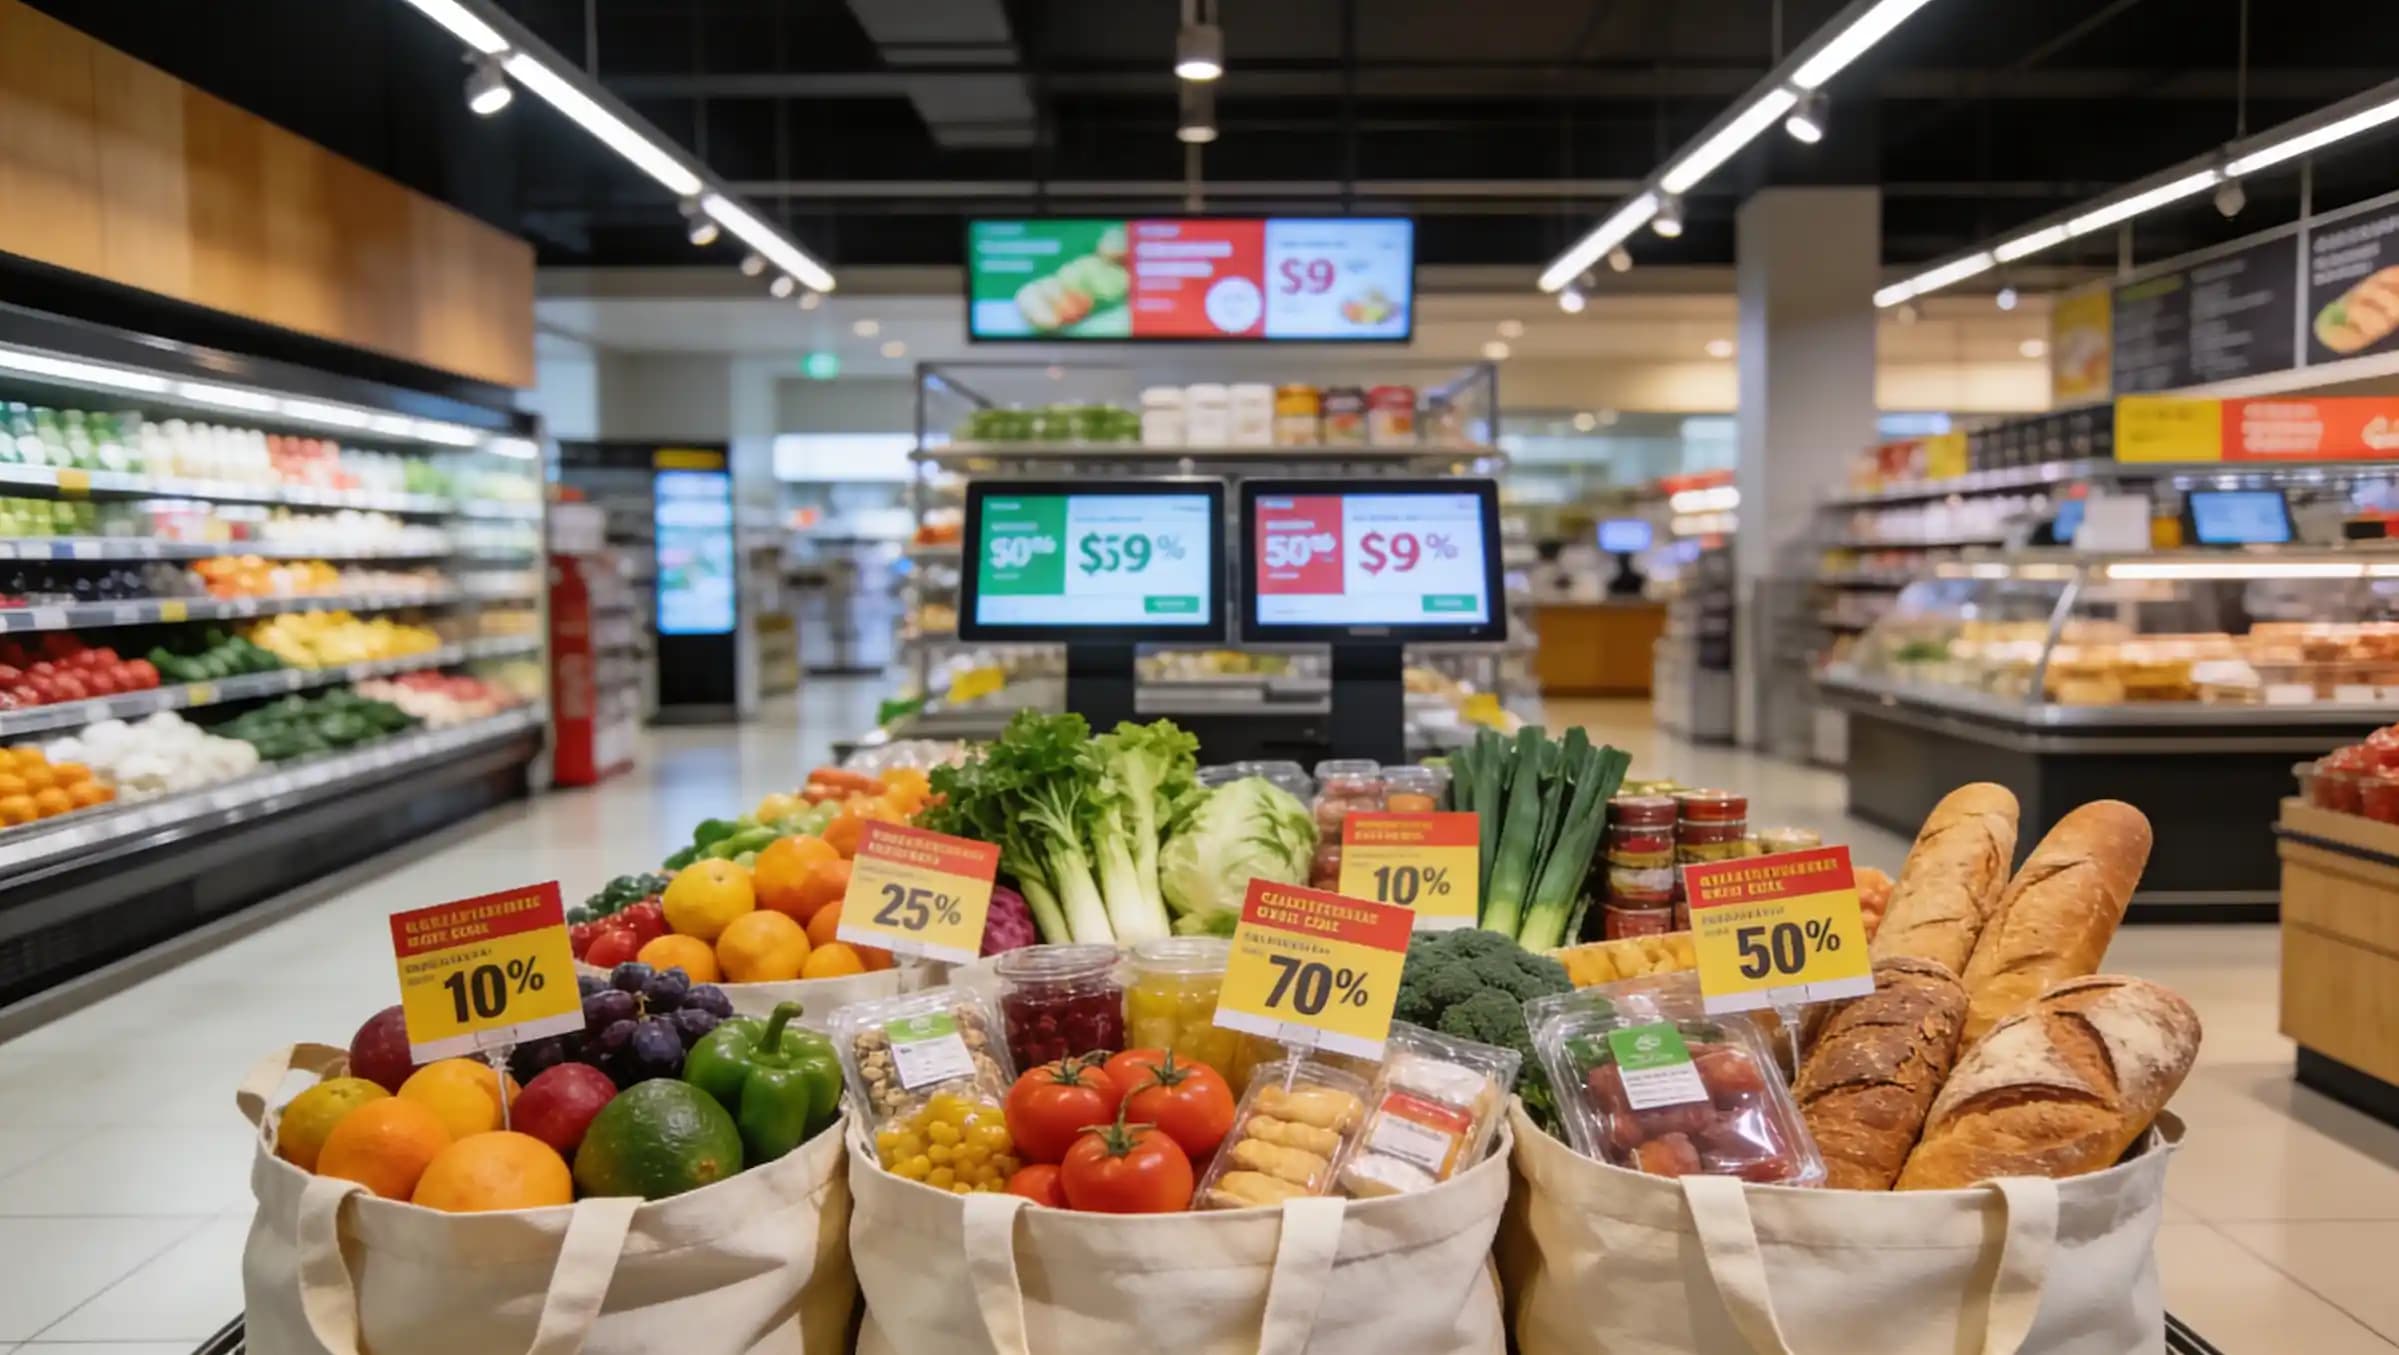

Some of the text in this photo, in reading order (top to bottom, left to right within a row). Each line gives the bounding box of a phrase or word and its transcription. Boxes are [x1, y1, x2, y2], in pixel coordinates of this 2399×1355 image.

[873, 883, 961, 931] 25%
[1374, 866, 1451, 905] 10%
[1737, 917, 1840, 980] 50%
[444, 955, 545, 1023] 10%
[1264, 954, 1368, 1016] 70%
